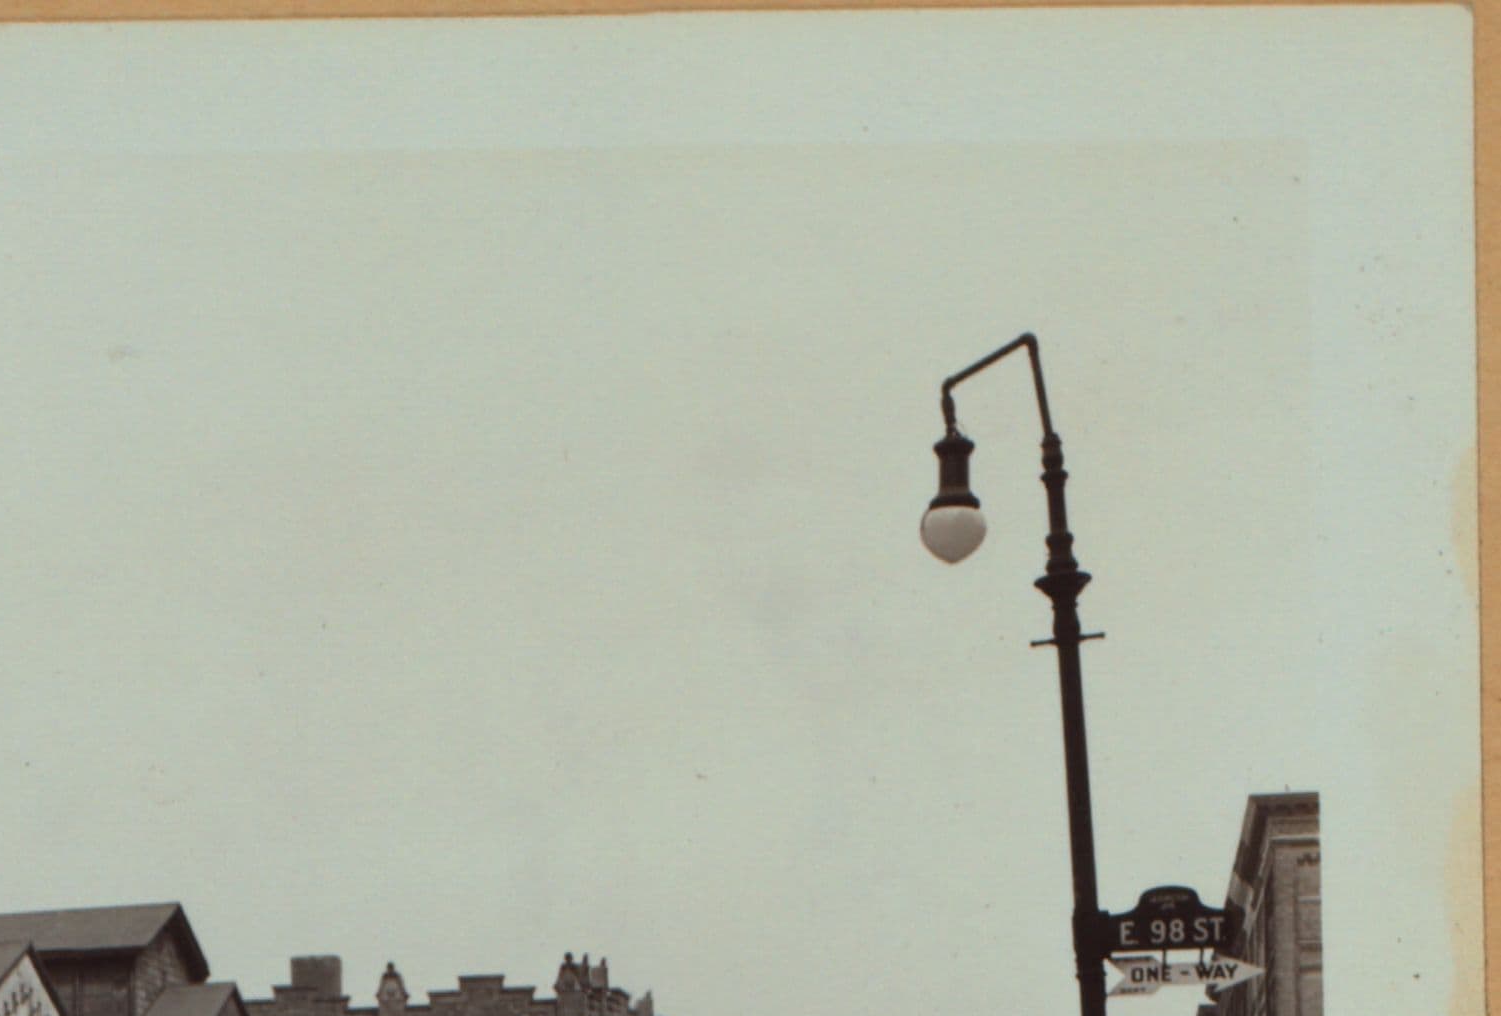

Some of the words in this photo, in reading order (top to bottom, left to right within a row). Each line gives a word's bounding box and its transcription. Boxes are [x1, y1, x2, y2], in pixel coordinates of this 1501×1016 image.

[1150, 919, 1185, 944] 98
[1130, 966, 1173, 984] ONE
[1195, 963, 1238, 980] WAY
